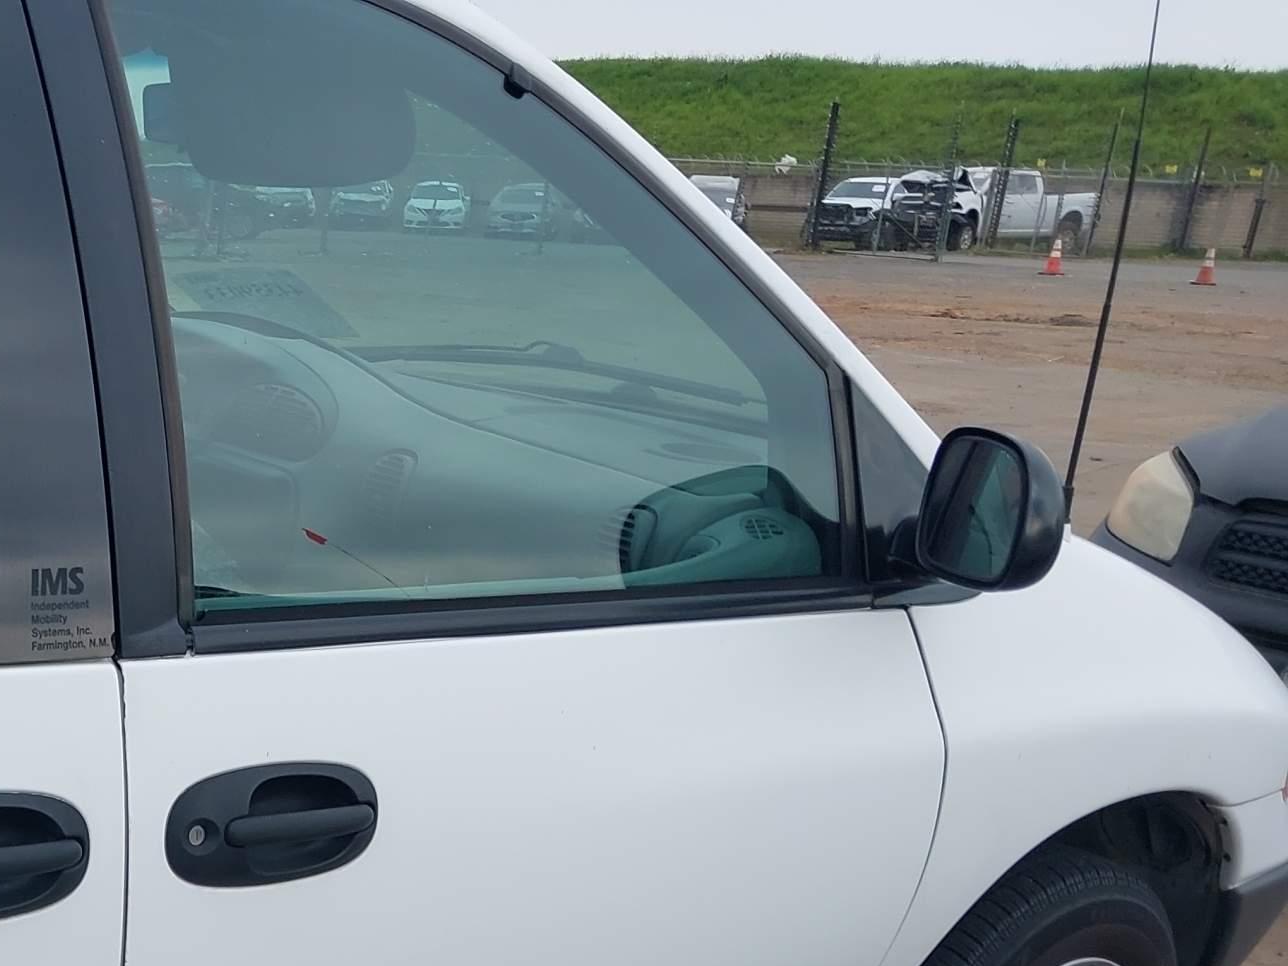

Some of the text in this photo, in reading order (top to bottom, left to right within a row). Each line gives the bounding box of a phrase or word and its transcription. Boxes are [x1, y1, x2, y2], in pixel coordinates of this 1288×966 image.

[31, 567, 84, 596] IMS
[31, 600, 89, 611] Independent
[31, 614, 68, 625] Mobility
[31, 625, 93, 639] Systems, Inc.
[88, 637, 110, 649] N.M.
